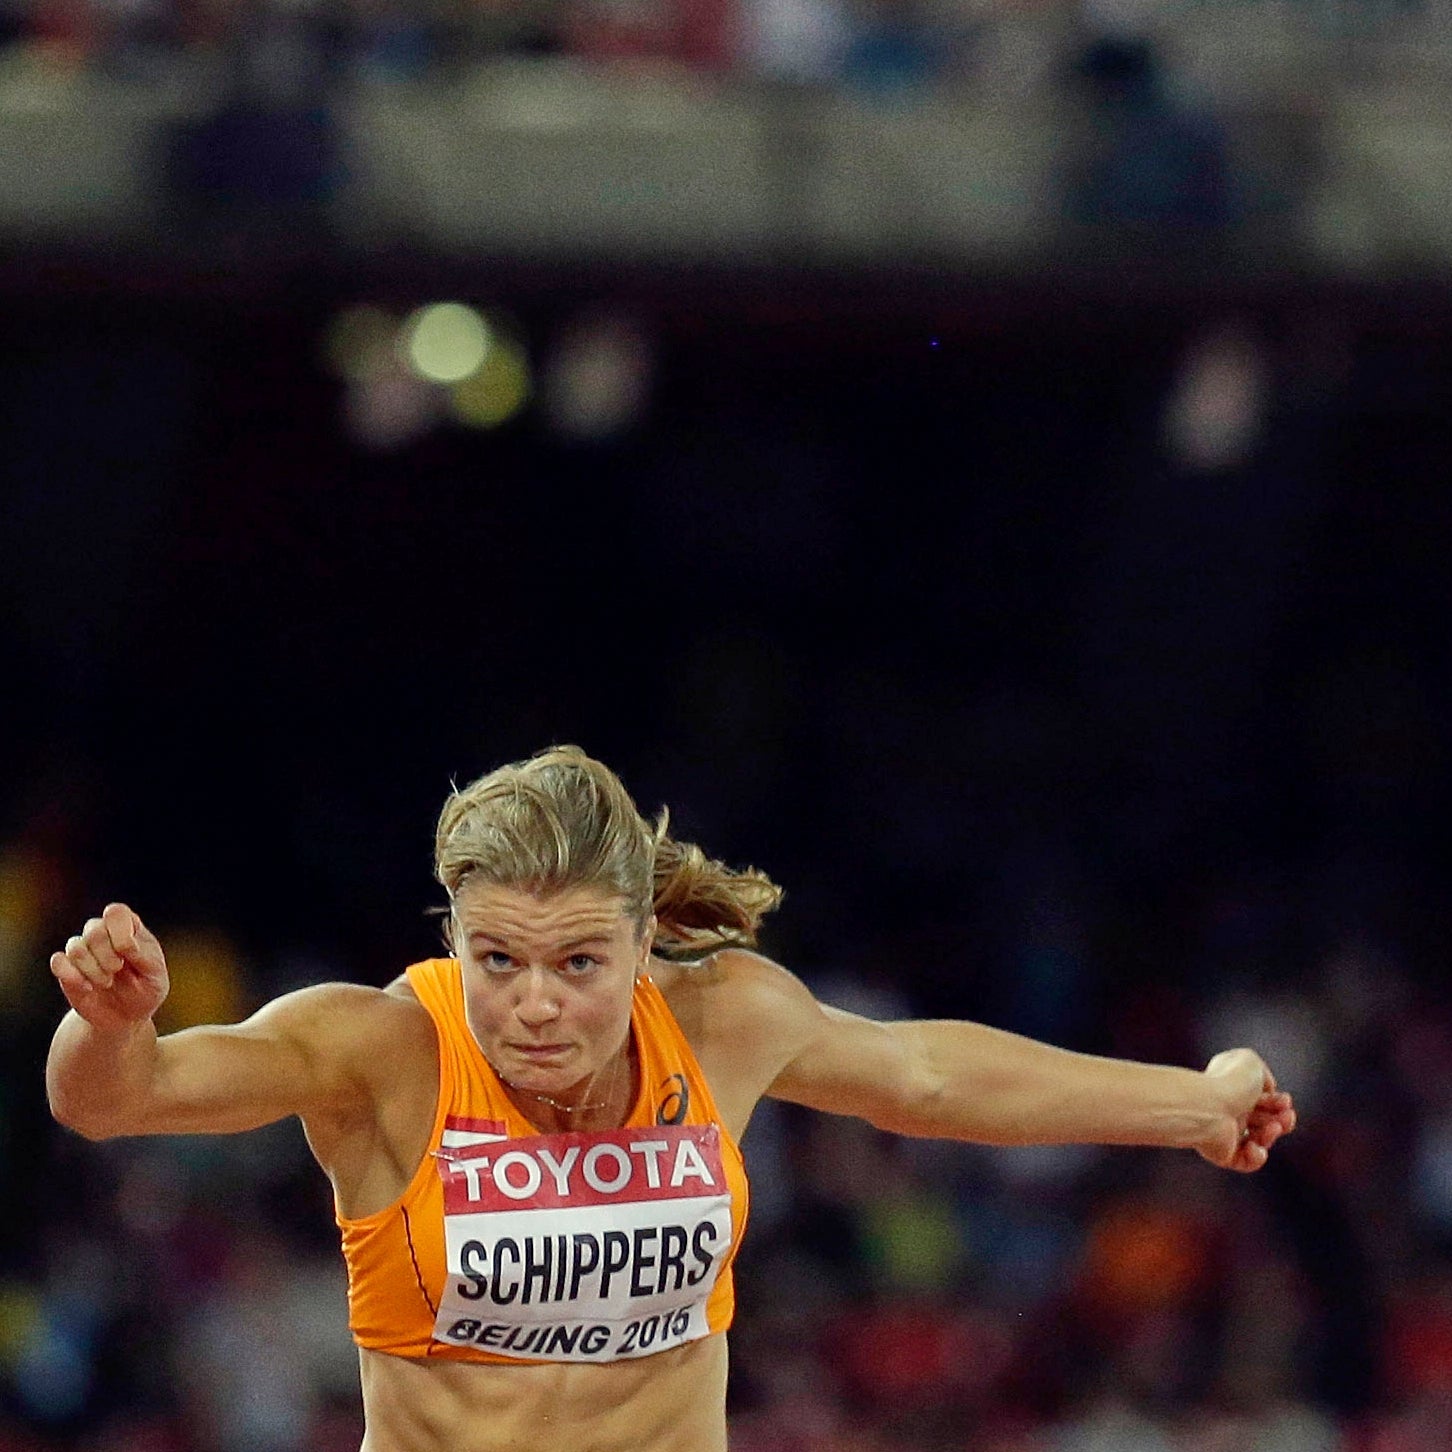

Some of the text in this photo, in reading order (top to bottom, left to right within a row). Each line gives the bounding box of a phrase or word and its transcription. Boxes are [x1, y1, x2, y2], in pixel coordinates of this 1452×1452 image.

[448, 1140, 716, 1202] TOYOTA
[457, 1221, 717, 1305] SCHIPPERS
[446, 1306, 691, 1355] BEIJING 2015
